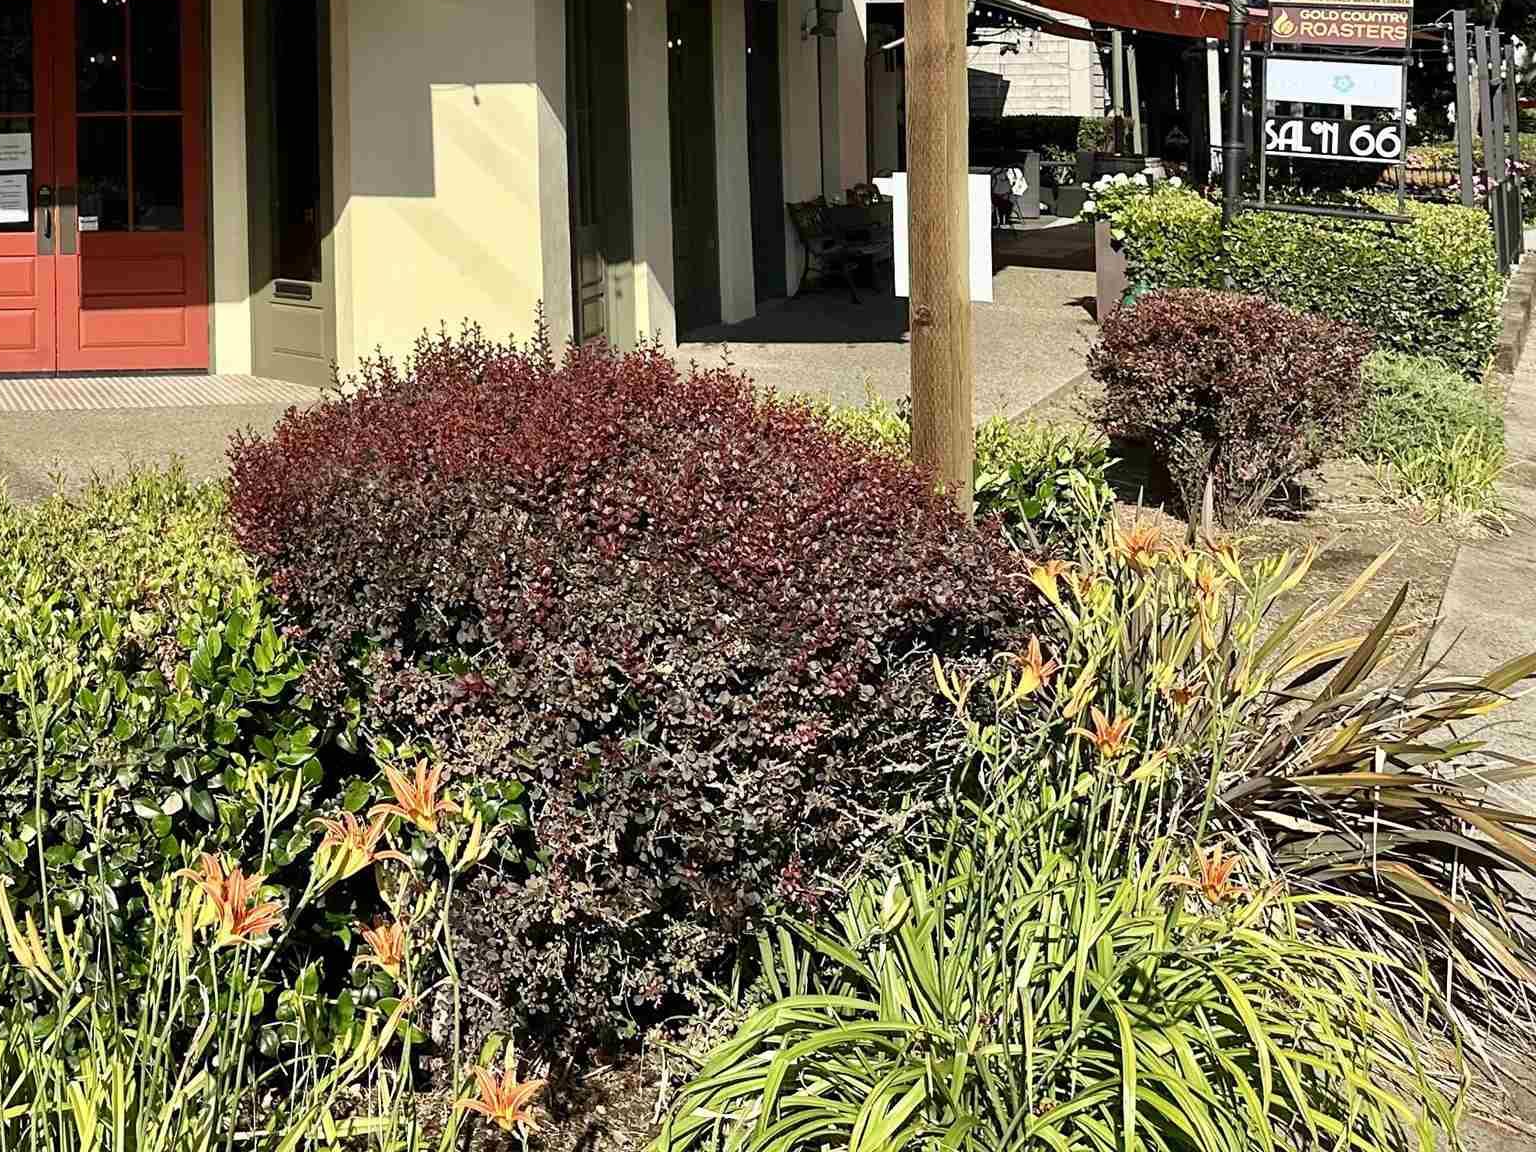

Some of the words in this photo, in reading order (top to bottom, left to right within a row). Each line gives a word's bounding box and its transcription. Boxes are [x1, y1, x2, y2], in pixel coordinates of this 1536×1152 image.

[1300, 9, 1339, 21] GOLD
[1341, 11, 1408, 24] COUNTRY
[1300, 22, 1408, 41] ROASTERS
[1349, 125, 1402, 158] 66
